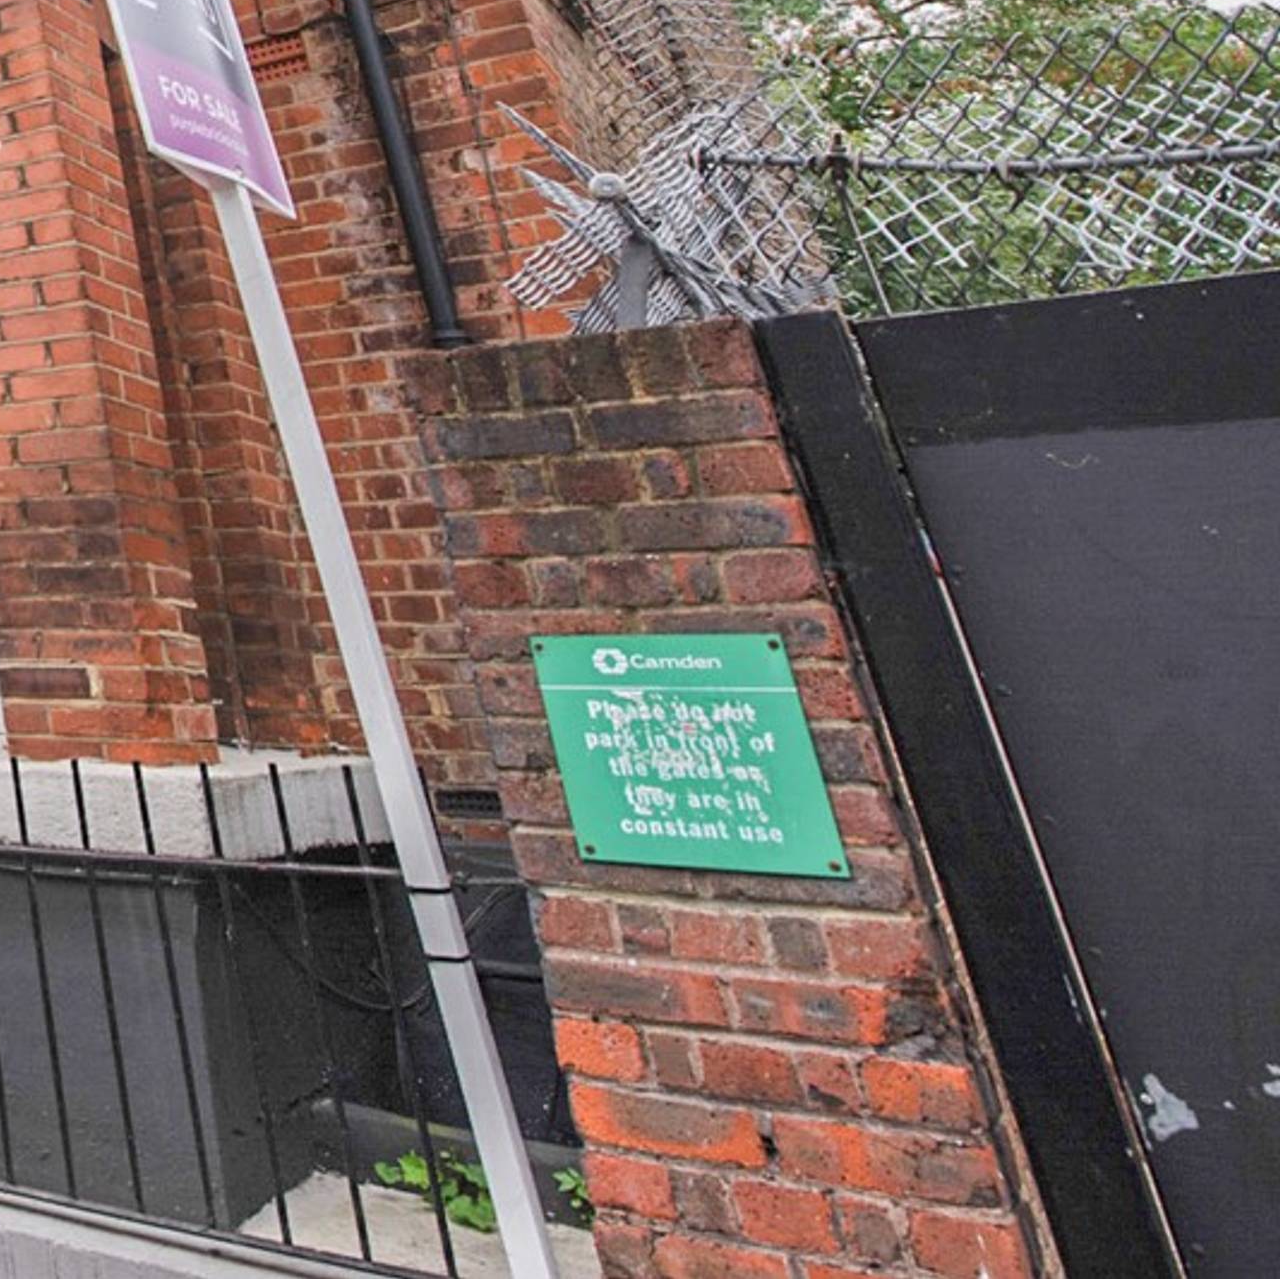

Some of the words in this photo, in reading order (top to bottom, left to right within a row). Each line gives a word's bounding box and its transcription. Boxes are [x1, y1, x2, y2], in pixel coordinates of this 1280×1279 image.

[158, 75, 202, 112] FOR
[630, 654, 722, 669] Camden
[587, 699, 666, 722] Please
[585, 731, 637, 750] park
[645, 731, 669, 749] in
[677, 731, 739, 755] front
[749, 732, 775, 753] of
[609, 756, 648, 777] the
[625, 783, 676, 811] they
[688, 791, 729, 810] are
[736, 791, 761, 811] in
[620, 817, 730, 840] constant
[739, 825, 784, 844] use
